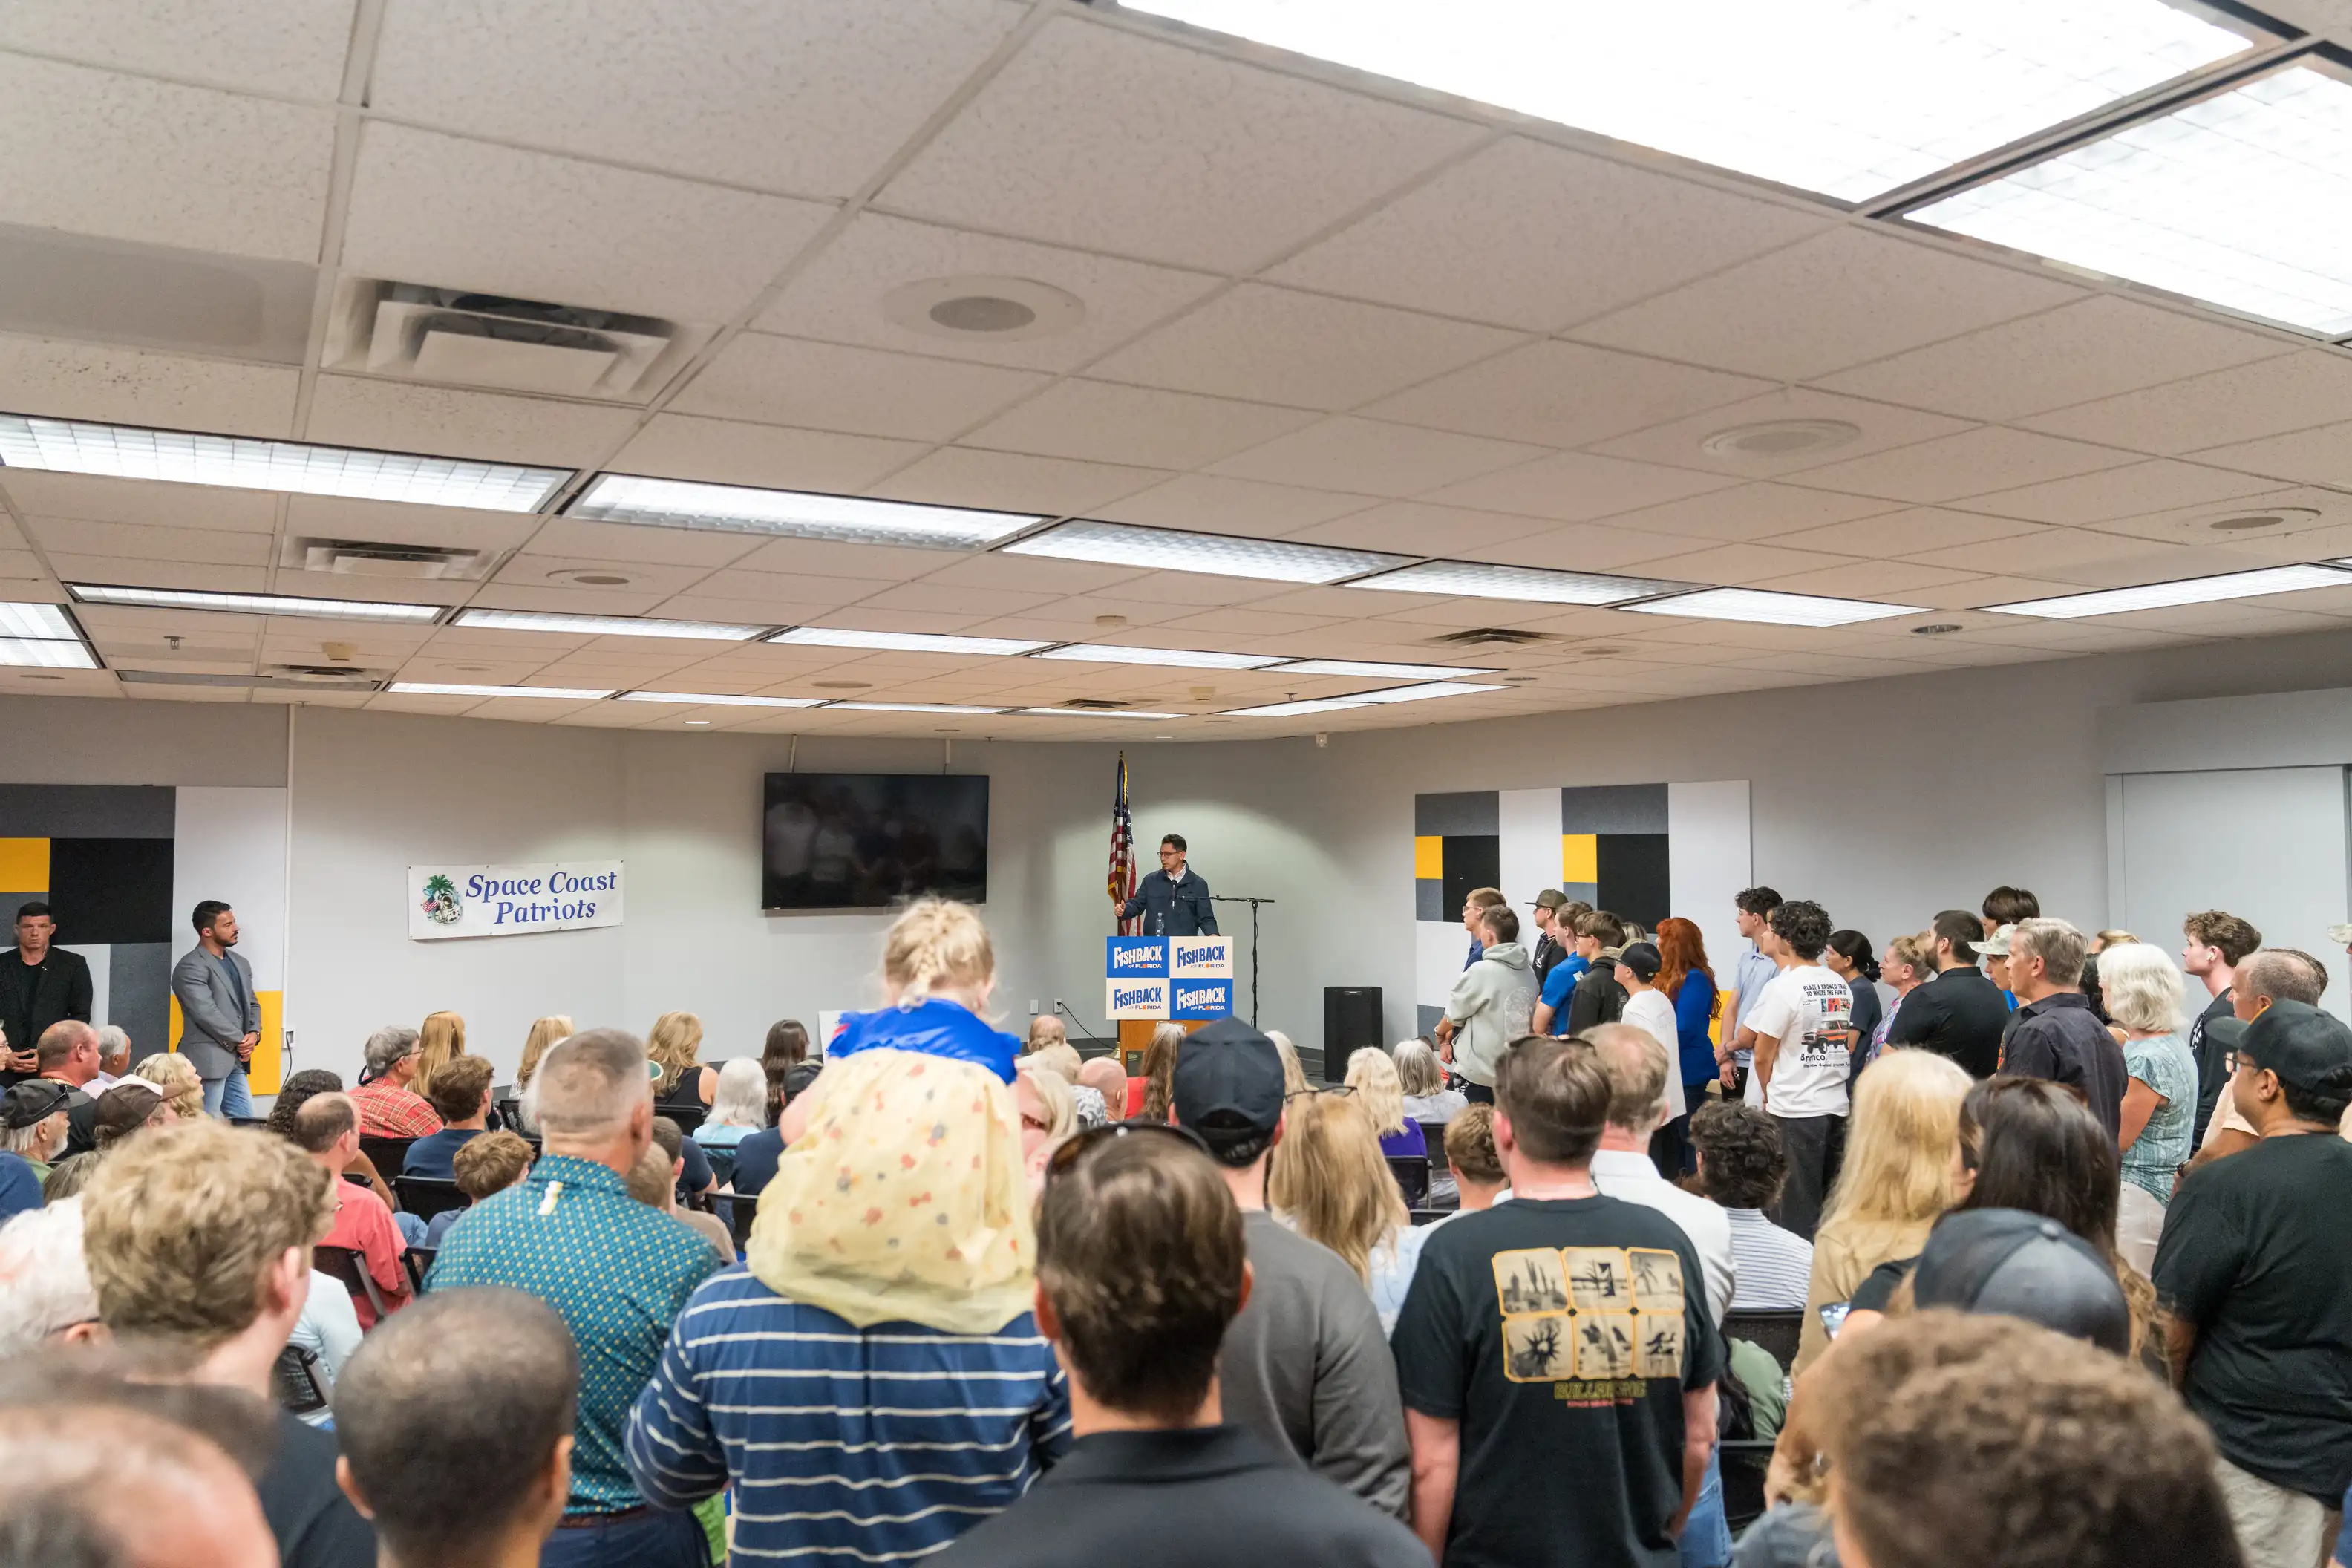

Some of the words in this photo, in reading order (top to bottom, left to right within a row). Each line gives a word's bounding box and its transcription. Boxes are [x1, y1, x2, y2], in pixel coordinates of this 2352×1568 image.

[466, 874, 542, 904] Space
[549, 871, 618, 894] Coast
[494, 898, 597, 924] Patriots
[1114, 945, 1163, 969] FISHBACK
[1177, 945, 1225, 968] FISHBACK
[1114, 987, 1162, 1010] FISHBACK
[1177, 987, 1226, 1010] FISHBACK
